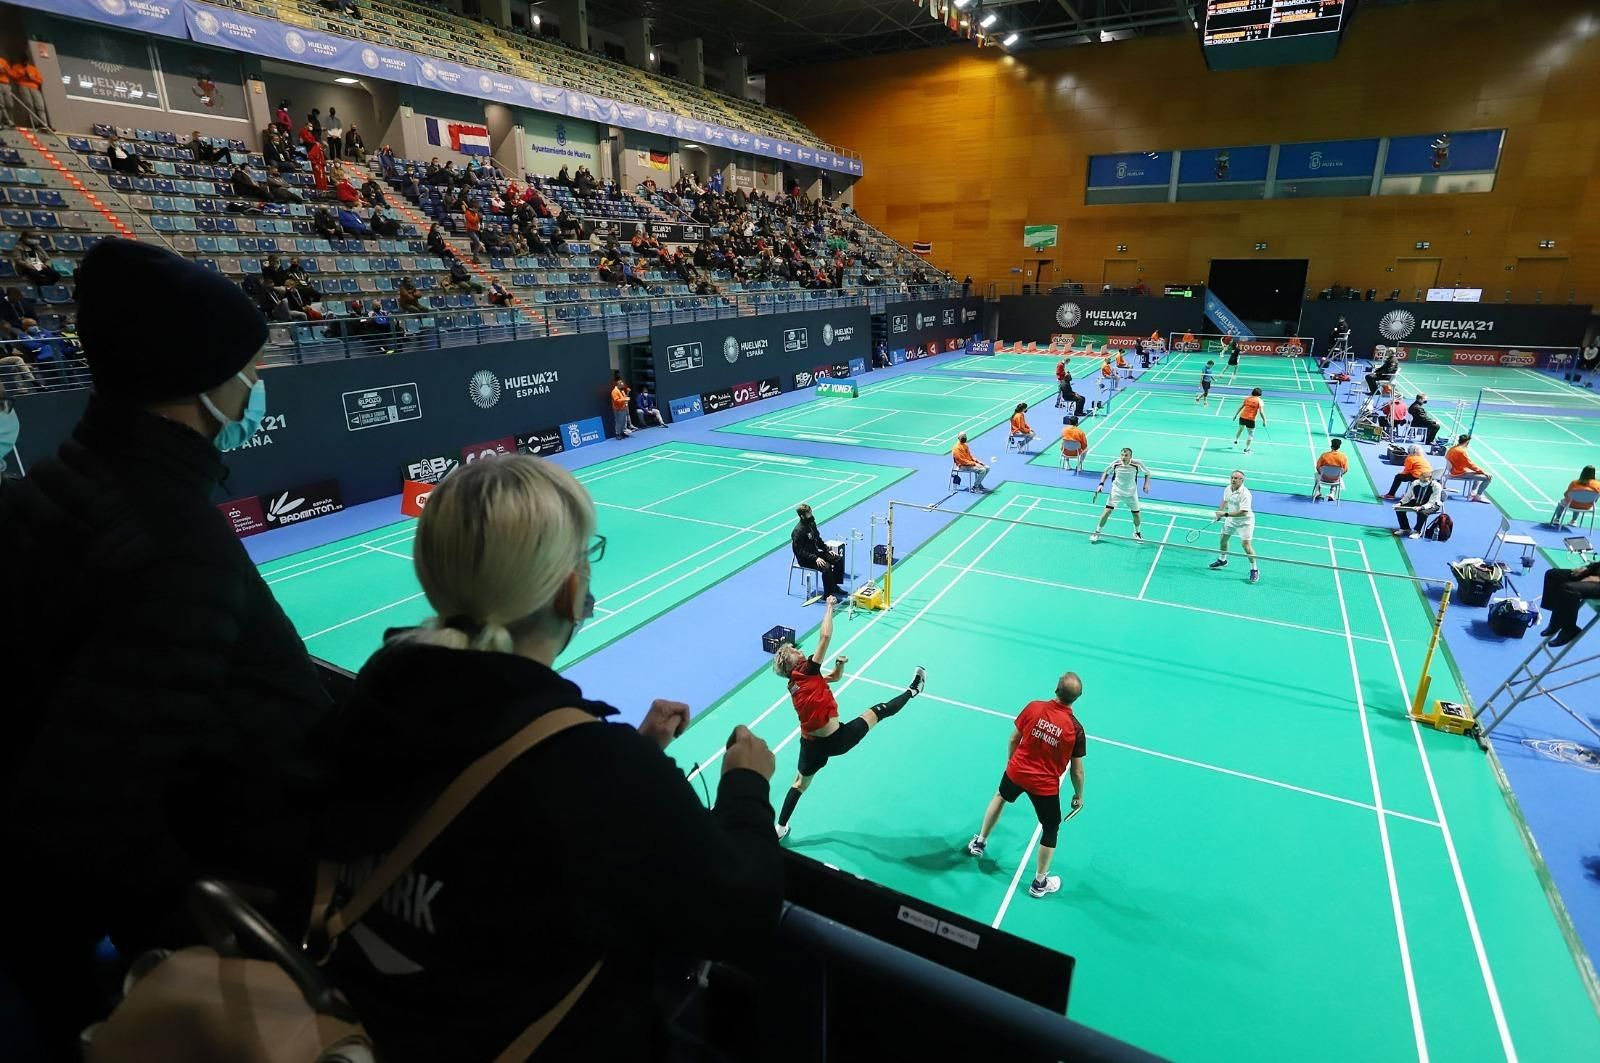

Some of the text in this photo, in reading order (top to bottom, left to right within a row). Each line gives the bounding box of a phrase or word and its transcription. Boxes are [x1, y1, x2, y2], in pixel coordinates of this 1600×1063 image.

[532, 144, 591, 159] Ayuntamiento de Huelva
[1086, 310, 1137, 320] HUELVA'21
[1093, 319, 1126, 327] ESPAÑA
[1420, 319, 1494, 331] HUELVA'21
[1431, 330, 1477, 339] ESPAÑA
[741, 339, 768, 351] HUELVA'21
[1109, 338, 1137, 346] TOYOTA
[1455, 353, 1495, 362] TOYOTA
[504, 370, 558, 389] HUELVA'21
[516, 385, 550, 398] ESPAÑA
[831, 384, 853, 393] YONEX
[312, 498, 333, 507] ESPAÑA
[232, 516, 251, 524] Consejo
[234, 520, 254, 528] Superior
[242, 522, 263, 531] Deportes
[1035, 717, 1063, 738] JEPSEN
[1031, 728, 1060, 748] DENMARK
